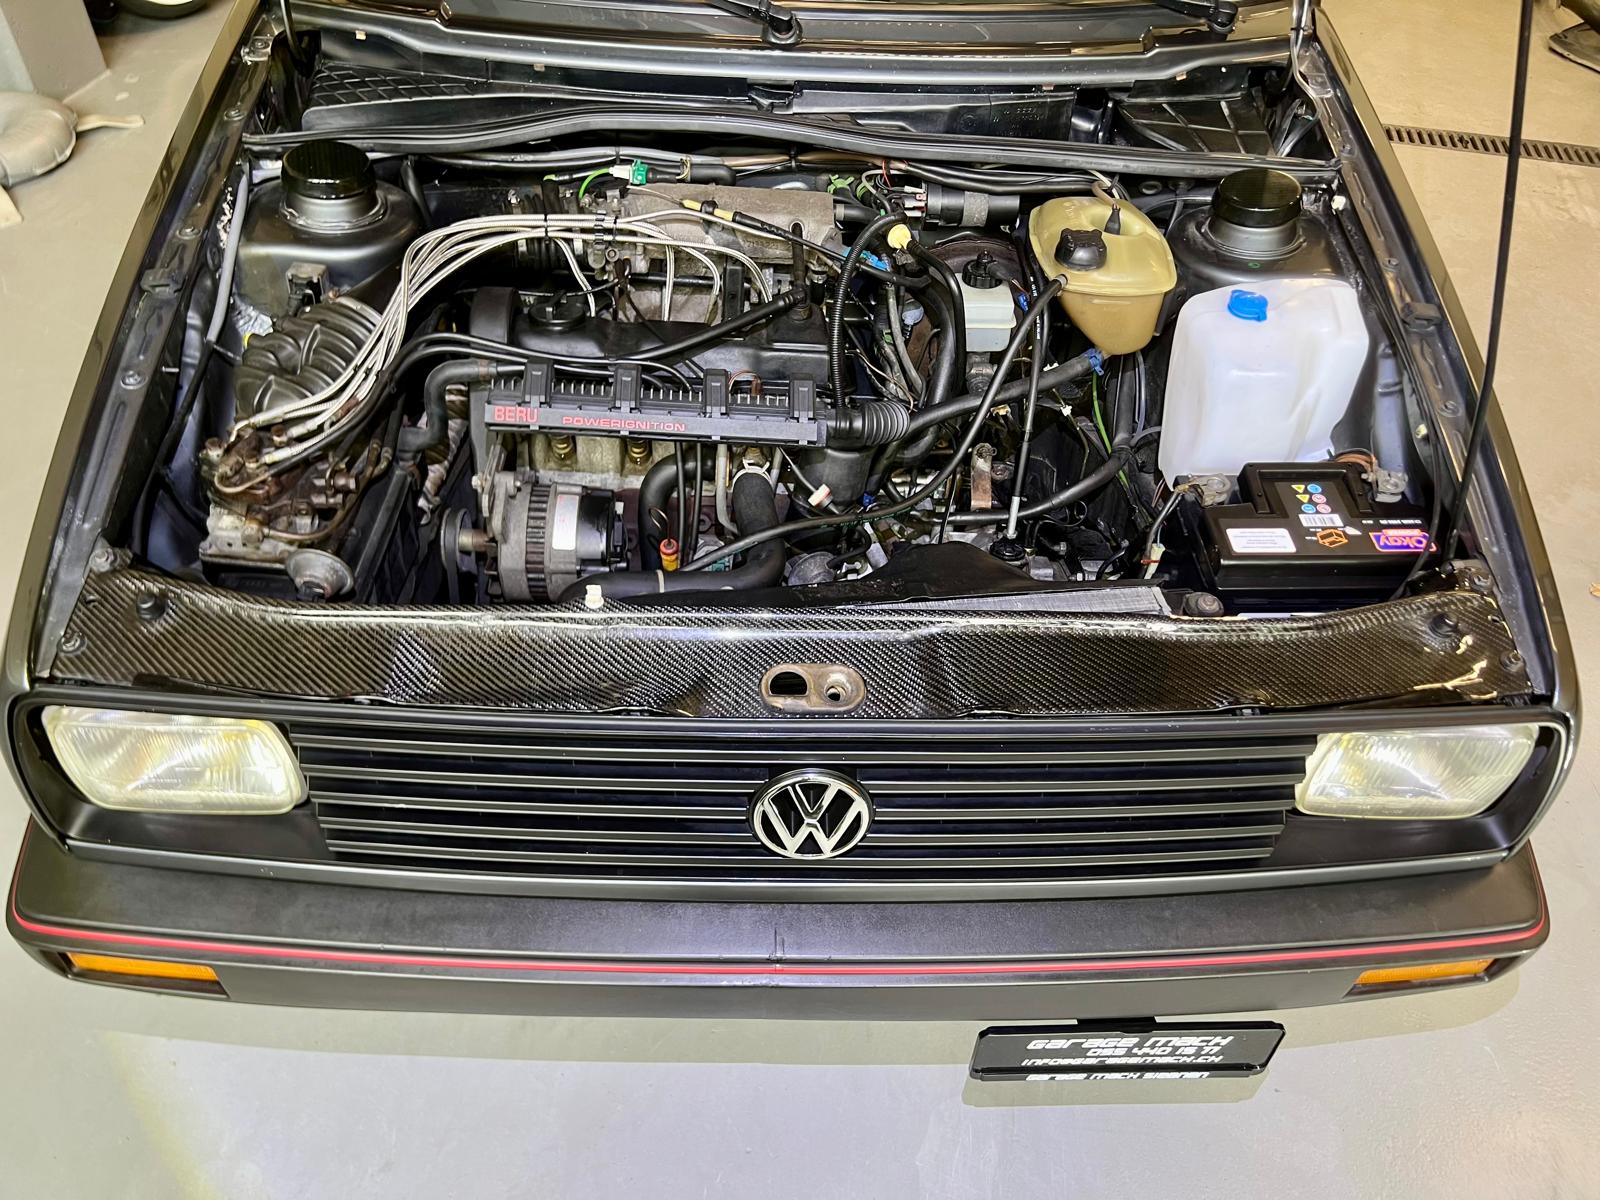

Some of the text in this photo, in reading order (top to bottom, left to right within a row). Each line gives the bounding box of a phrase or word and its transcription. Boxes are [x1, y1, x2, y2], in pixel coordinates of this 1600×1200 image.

[494, 407, 686, 431] BERU POWERIGNITION
[1380, 535, 1427, 548] Okay
[755, 776, 869, 859] VW
[1132, 1046, 1172, 1055] 440
